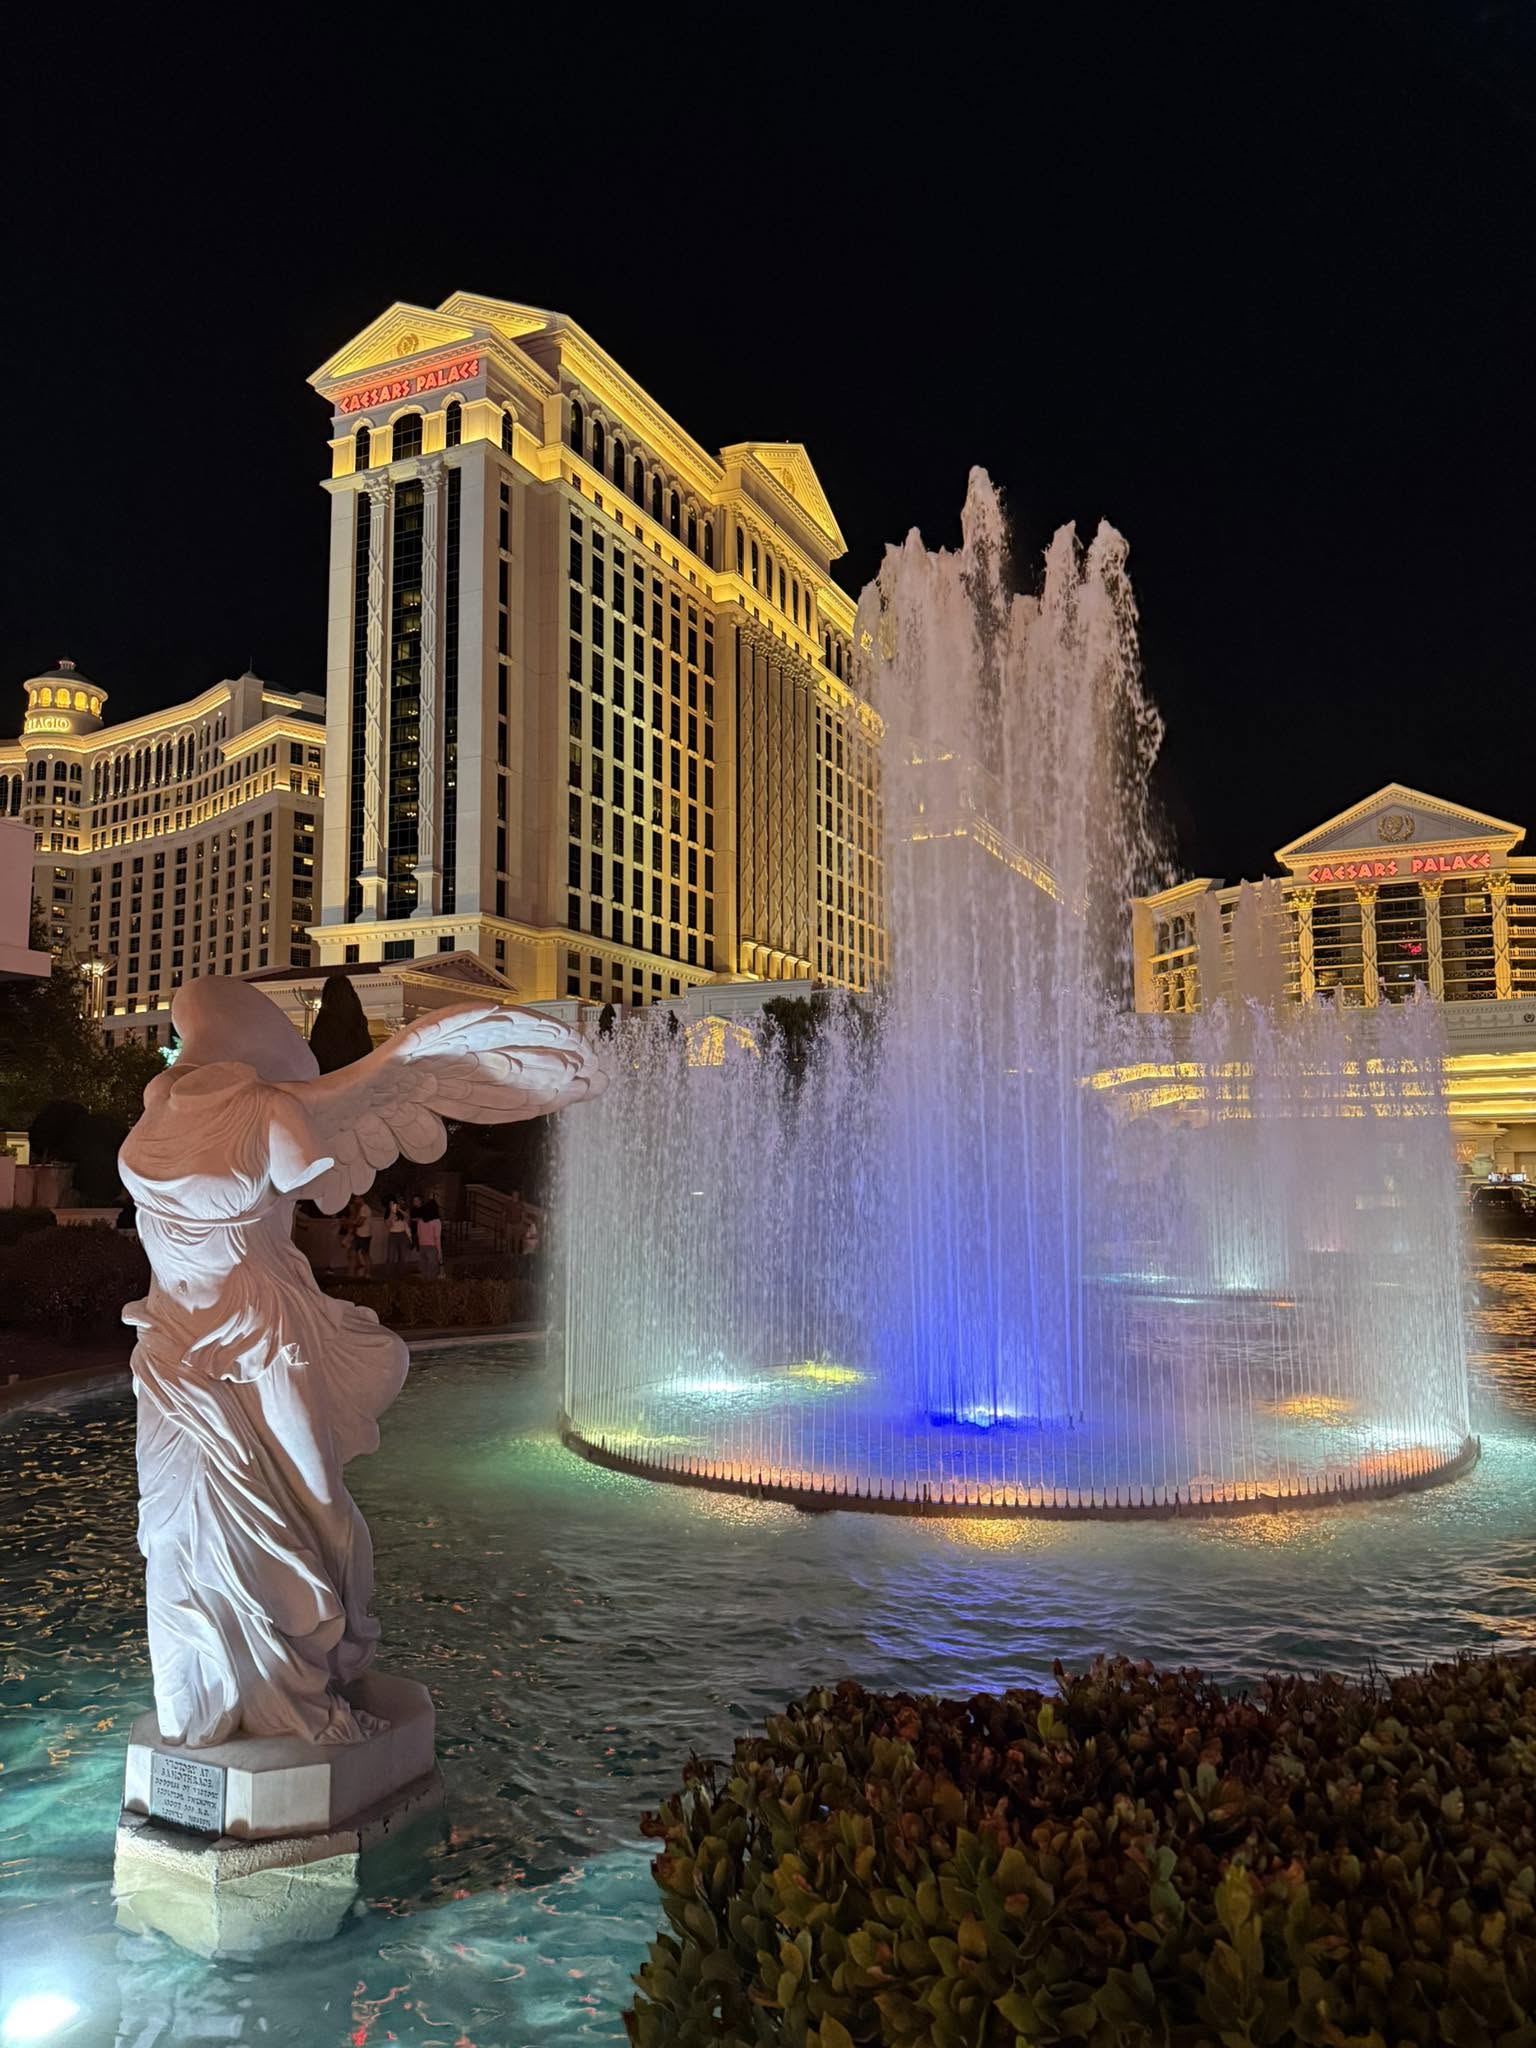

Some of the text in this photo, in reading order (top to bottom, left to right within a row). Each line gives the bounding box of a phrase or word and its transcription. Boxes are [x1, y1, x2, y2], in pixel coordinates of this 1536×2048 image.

[340, 359, 479, 414] CAESARS PALACE
[1308, 852, 1491, 883] CAESARS PALACE
